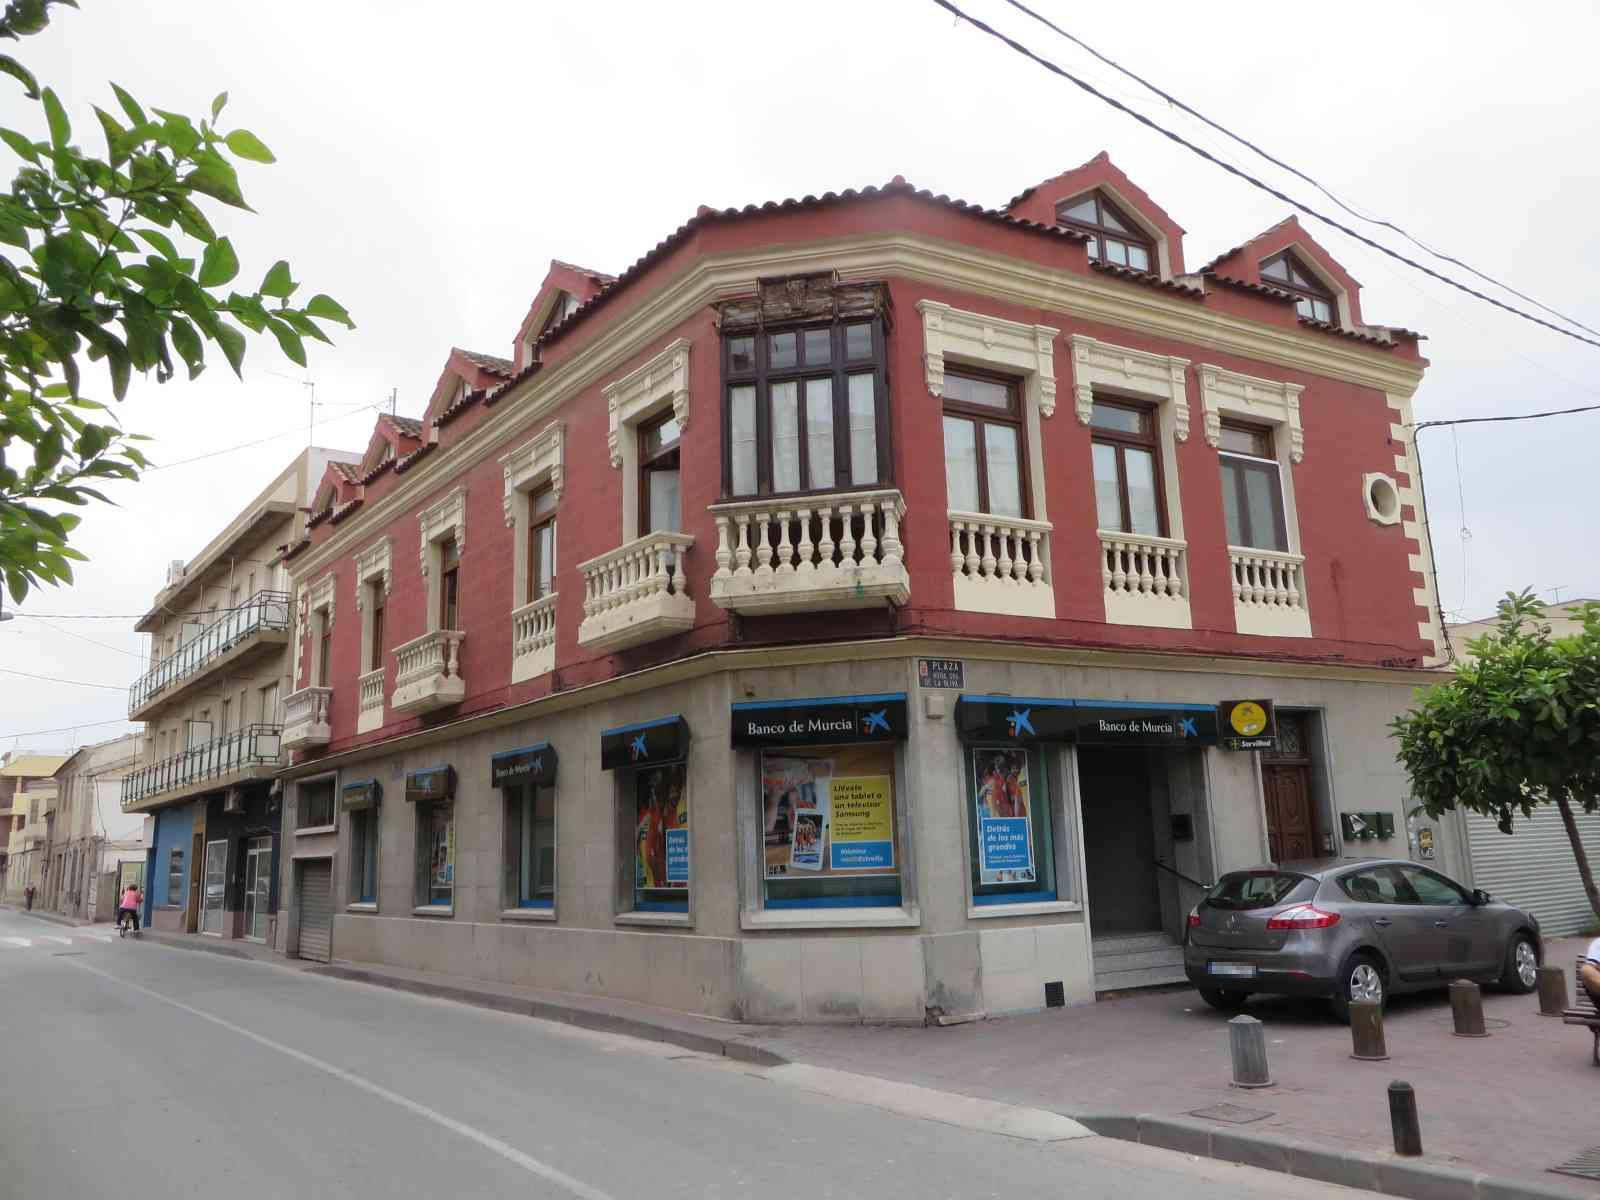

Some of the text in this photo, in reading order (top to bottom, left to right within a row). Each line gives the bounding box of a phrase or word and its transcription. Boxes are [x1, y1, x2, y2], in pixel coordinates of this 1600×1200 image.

[932, 662, 959, 671] PLAZA
[748, 719, 853, 735] Banco de Murcia
[1099, 719, 1173, 733] Banco de Murcia
[850, 792, 874, 800] tablet
